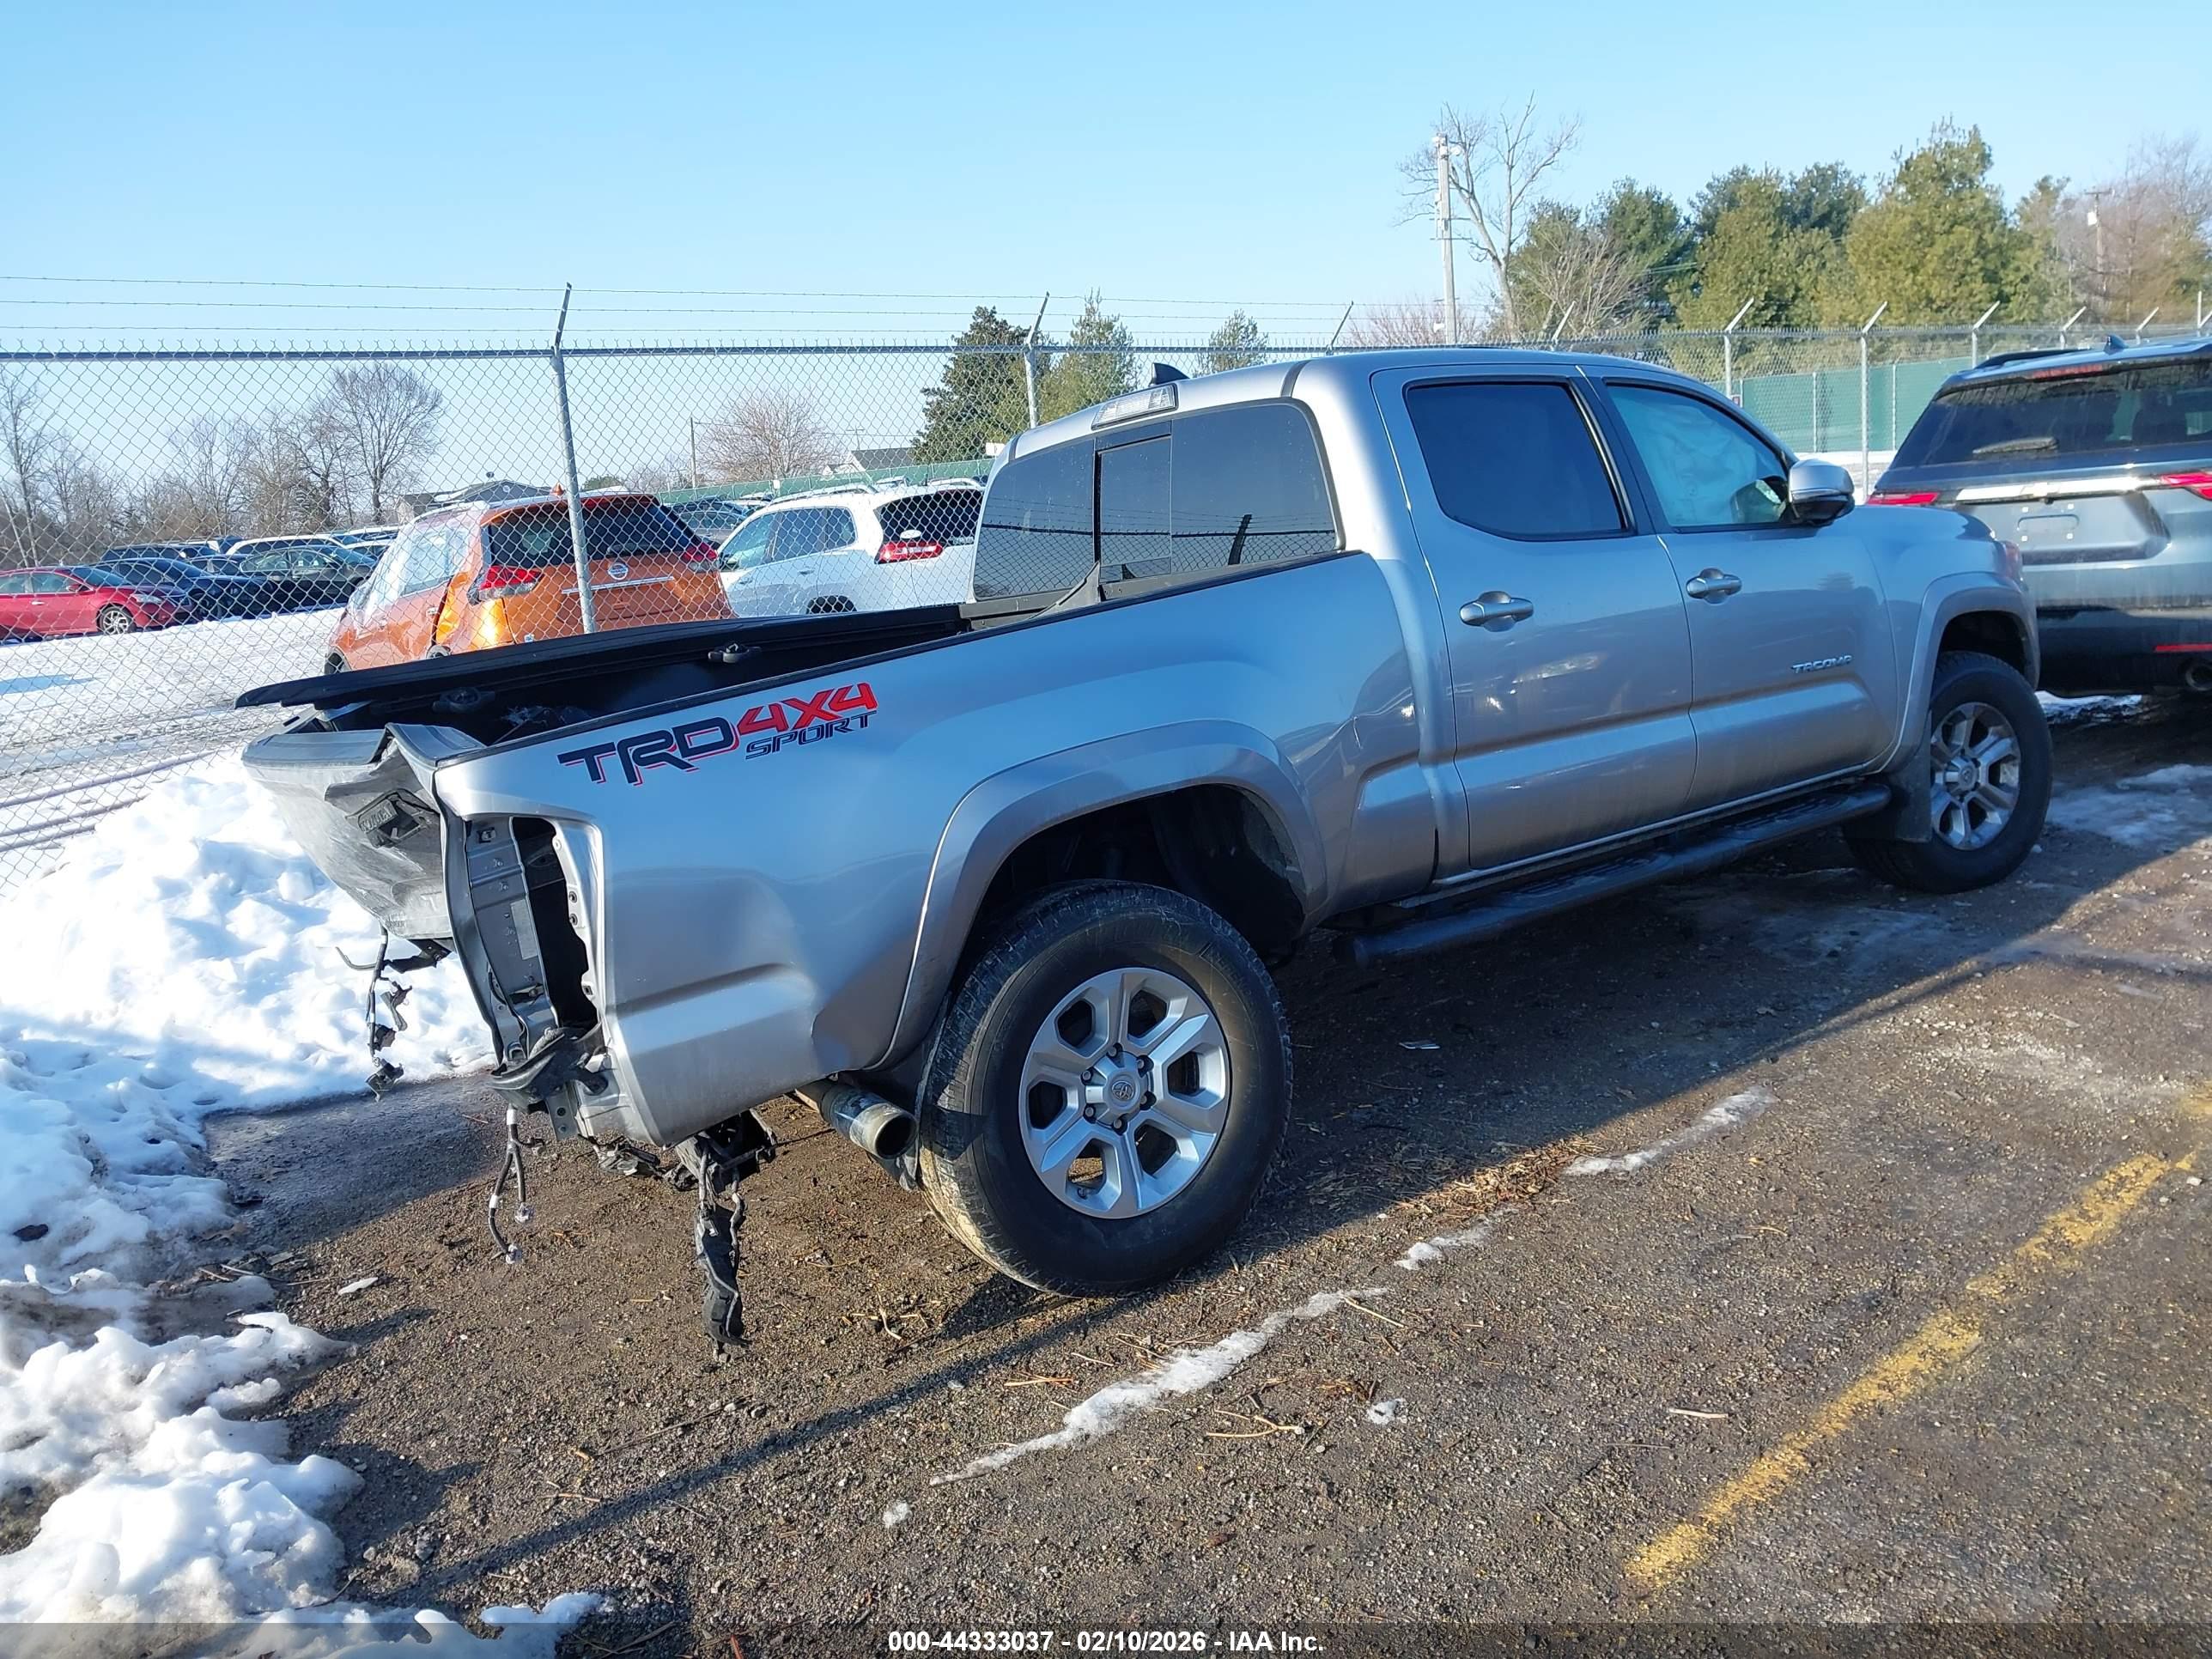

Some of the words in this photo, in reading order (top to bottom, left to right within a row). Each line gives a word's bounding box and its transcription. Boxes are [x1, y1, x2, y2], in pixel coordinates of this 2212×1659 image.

[556, 716, 740, 786] TRD
[736, 682, 878, 736] 4X4
[744, 710, 878, 760] SPORT
